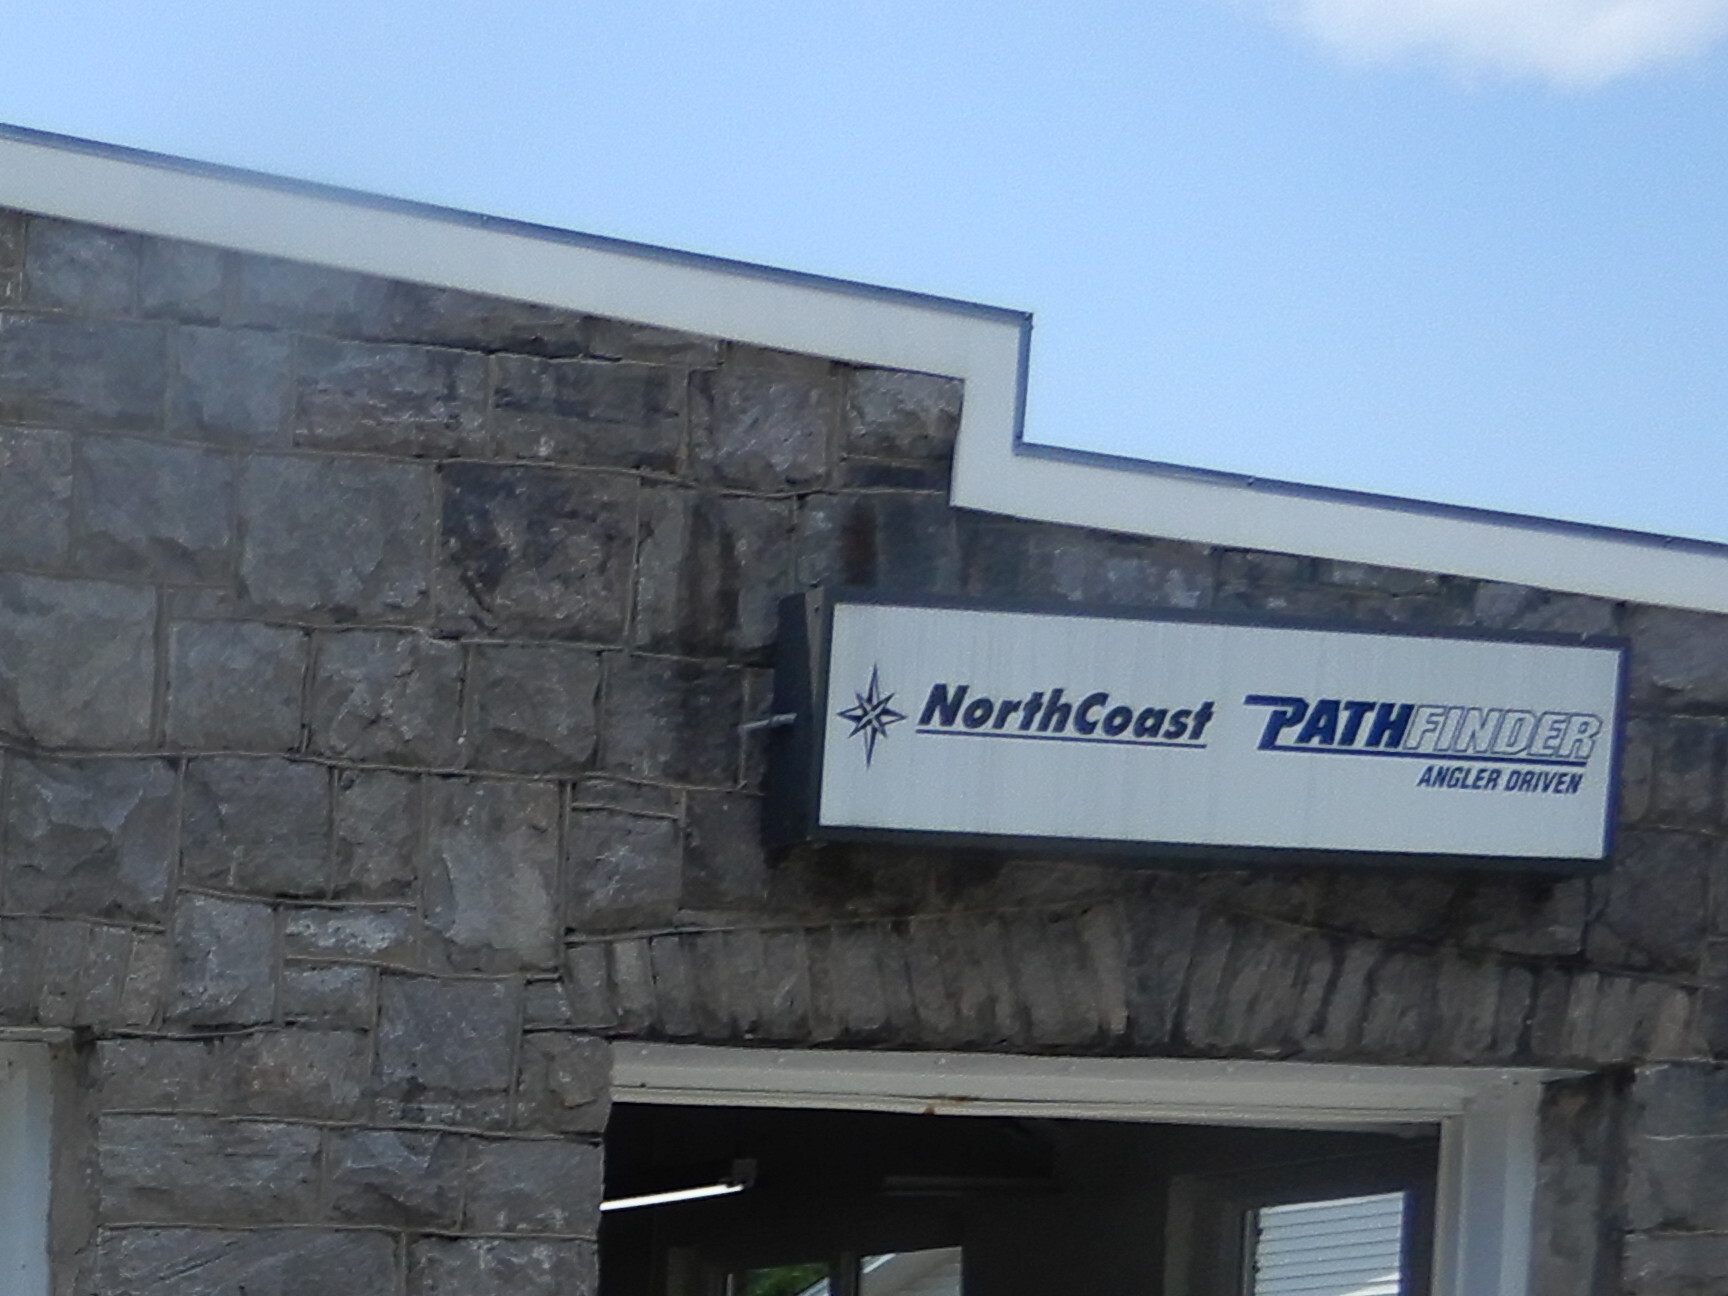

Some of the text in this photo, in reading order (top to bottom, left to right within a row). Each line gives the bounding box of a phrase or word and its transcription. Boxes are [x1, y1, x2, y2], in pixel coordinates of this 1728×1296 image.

[917, 682, 1215, 741] NorthCoast
[1243, 694, 1604, 760] PATHFINDER
[1416, 764, 1585, 795] ANGLER DRIVEN
